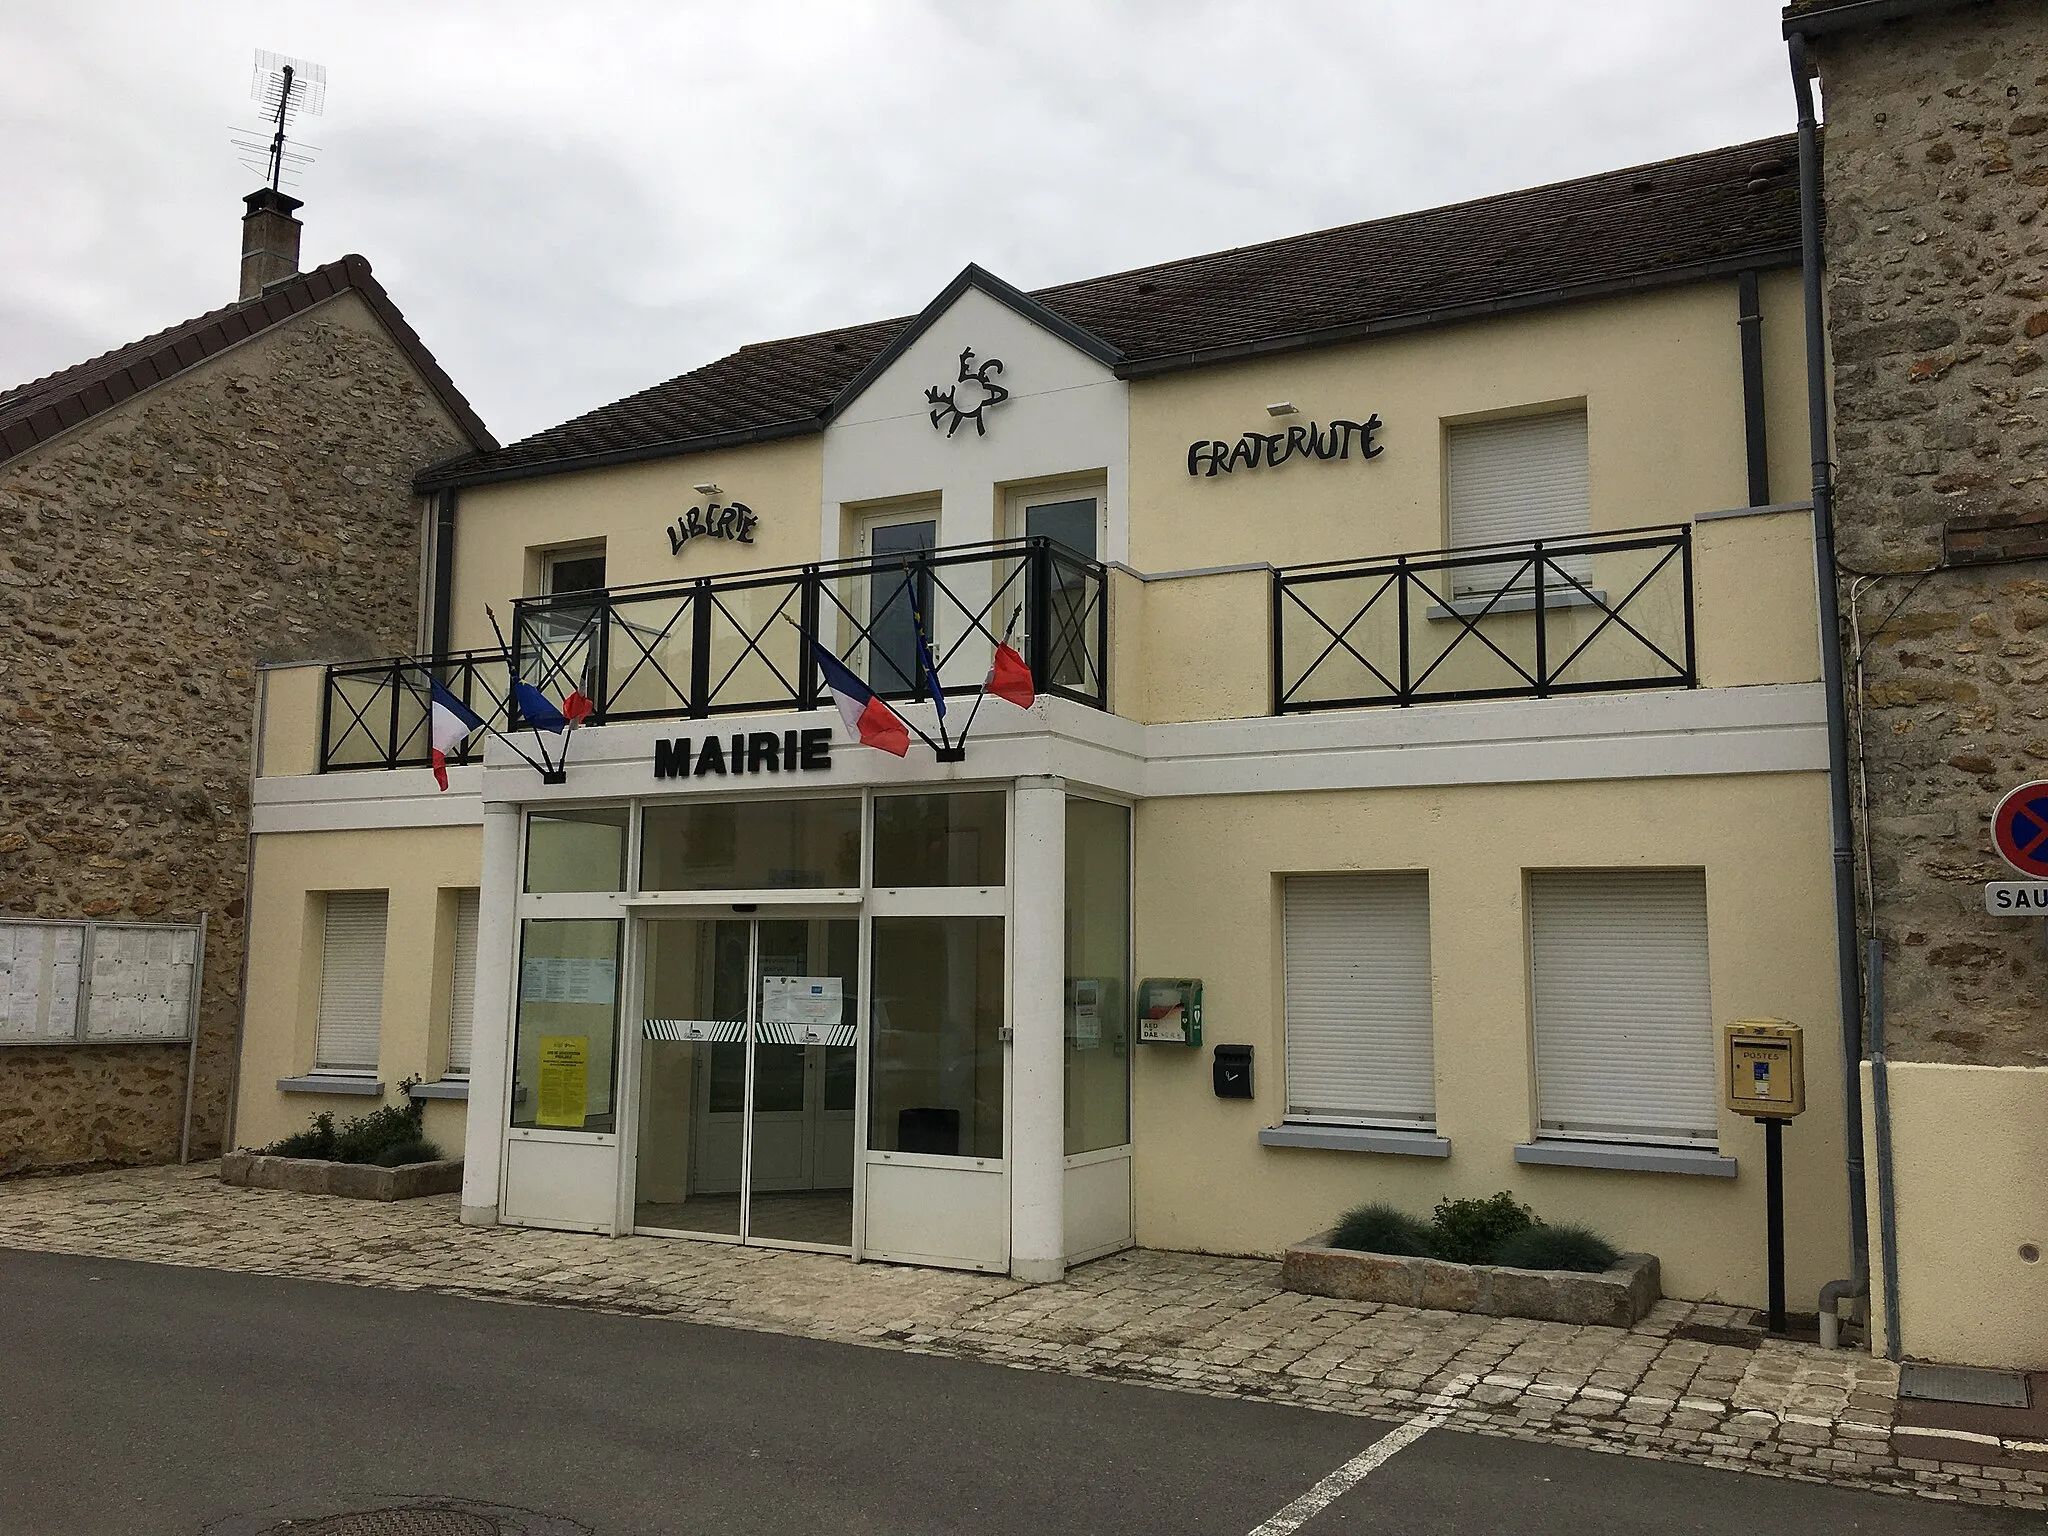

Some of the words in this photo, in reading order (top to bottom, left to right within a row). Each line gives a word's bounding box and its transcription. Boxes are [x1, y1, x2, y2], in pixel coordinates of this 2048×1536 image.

[667, 502, 758, 555] LIBERTÉ
[654, 728, 833, 778] MAIRIE
[1996, 889, 2048, 909] SAU
[1743, 1051, 1780, 1060] POSTES
